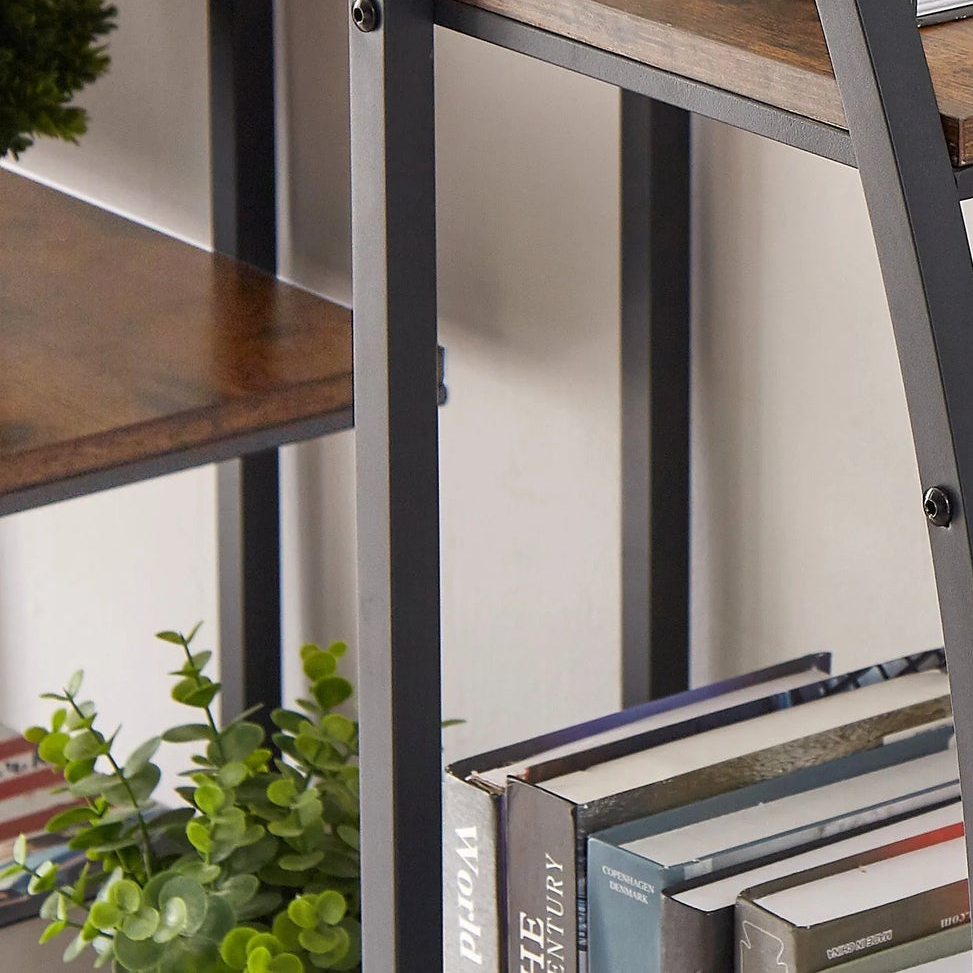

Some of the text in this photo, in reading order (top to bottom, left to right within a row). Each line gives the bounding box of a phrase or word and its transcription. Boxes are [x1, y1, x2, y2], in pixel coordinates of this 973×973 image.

[602, 865, 655, 894] COPENHAGEN
[609, 880, 649, 905] DENMARK
[455, 826, 483, 965] World
